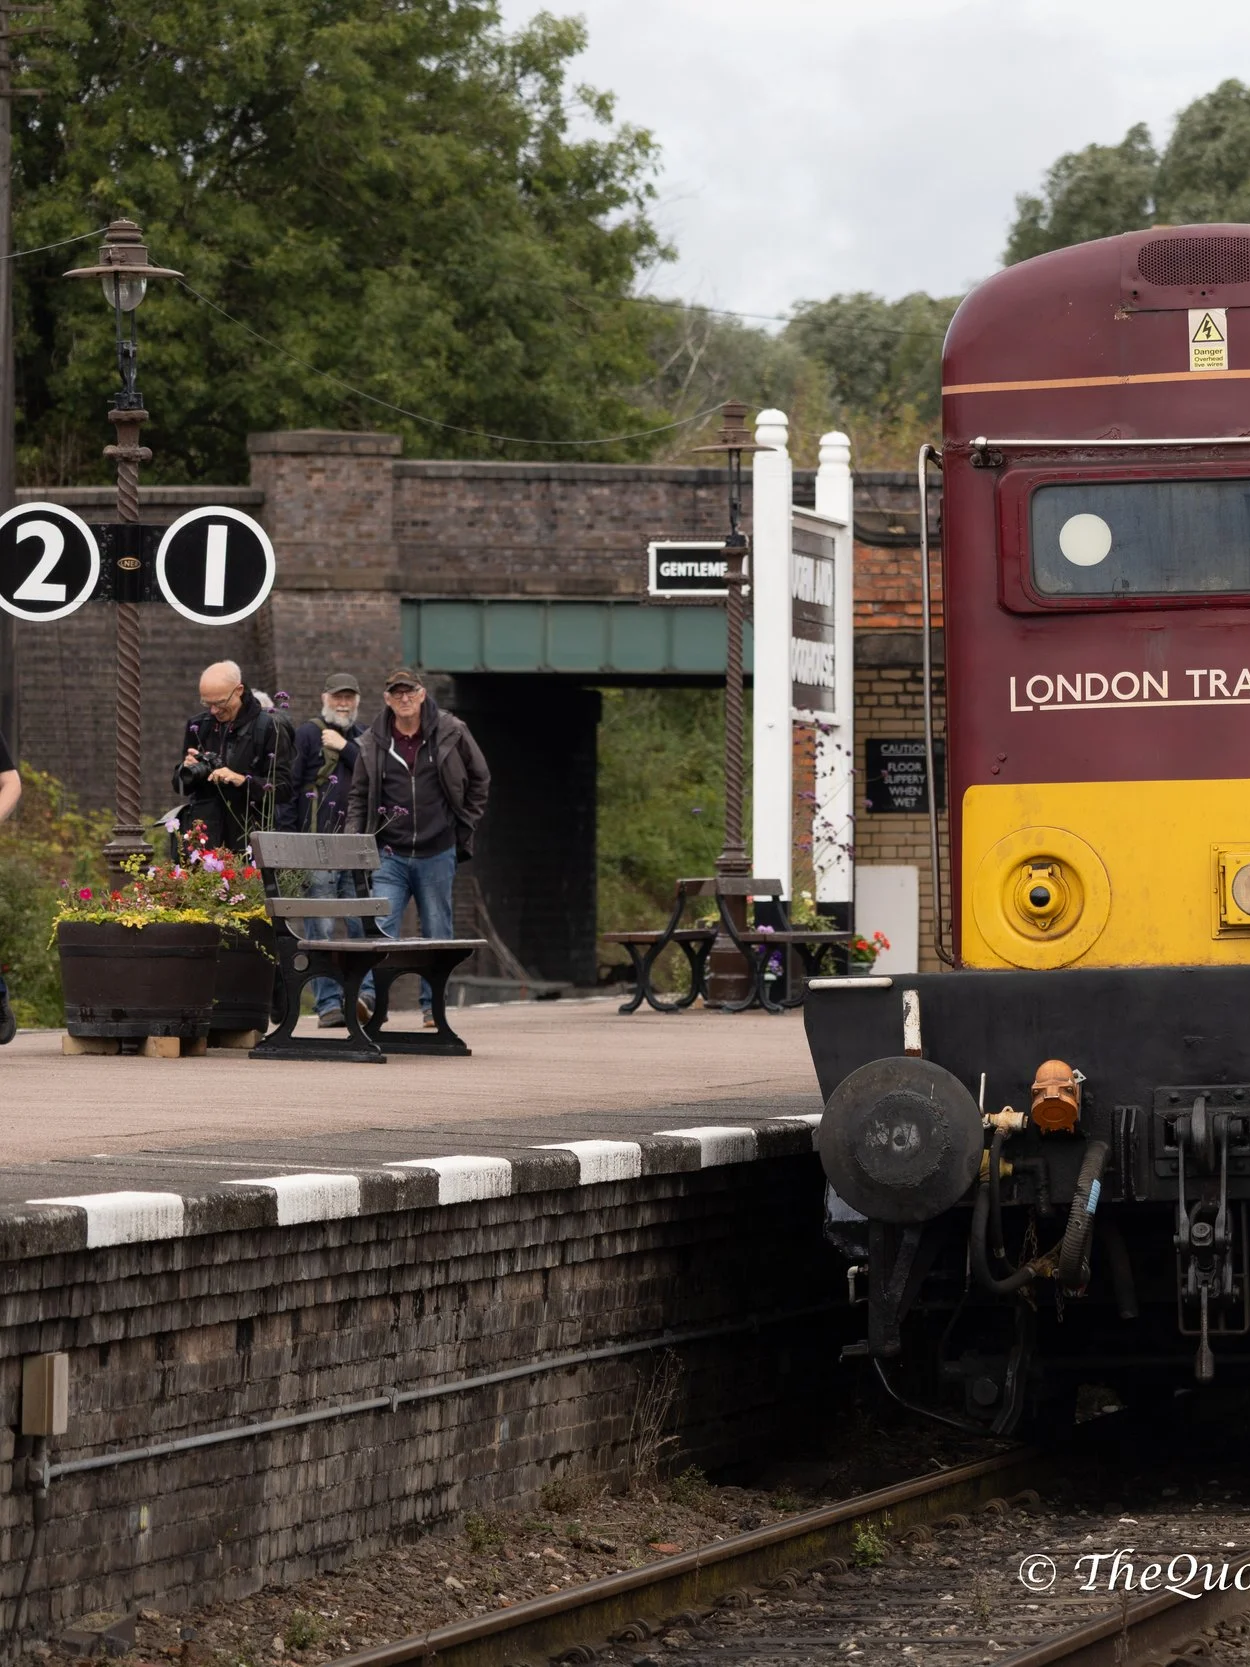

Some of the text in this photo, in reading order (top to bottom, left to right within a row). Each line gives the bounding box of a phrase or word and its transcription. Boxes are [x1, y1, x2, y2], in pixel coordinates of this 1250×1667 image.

[1194, 348, 1223, 356] Danger
[13, 520, 66, 602] 2
[204, 524, 228, 607] 1
[660, 561, 729, 578] GENTLEME
[1010, 670, 1168, 712] LONDON
[887, 762, 922, 772] FLOOR
[883, 774, 926, 784] SLIPPERY
[888, 786, 922, 796] WHEN
[893, 797, 917, 807] WET
